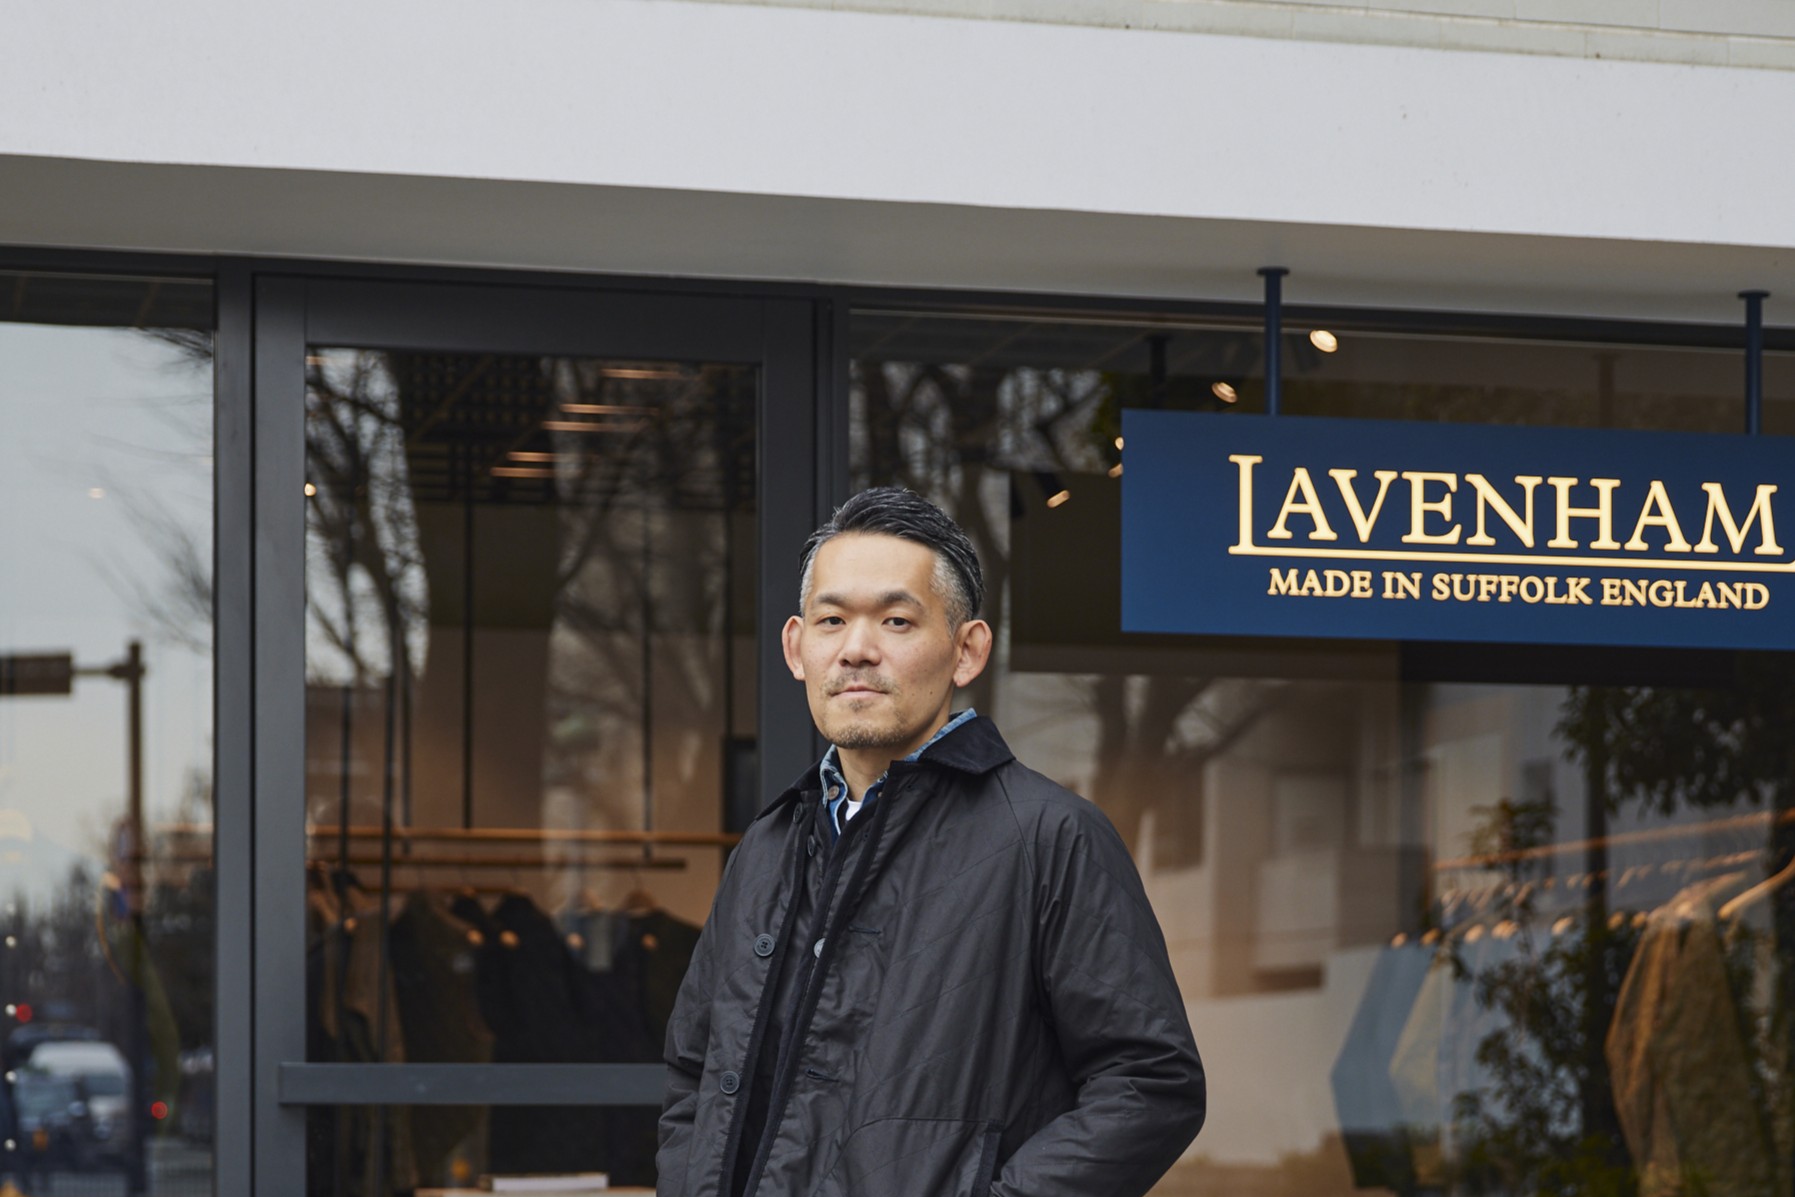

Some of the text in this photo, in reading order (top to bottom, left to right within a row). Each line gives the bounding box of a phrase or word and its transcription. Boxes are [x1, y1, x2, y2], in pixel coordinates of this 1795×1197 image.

[1228, 454, 1784, 556] LAVENHAM
[1267, 568, 1770, 610] MADE IN SUFFOLK ENGLAND
